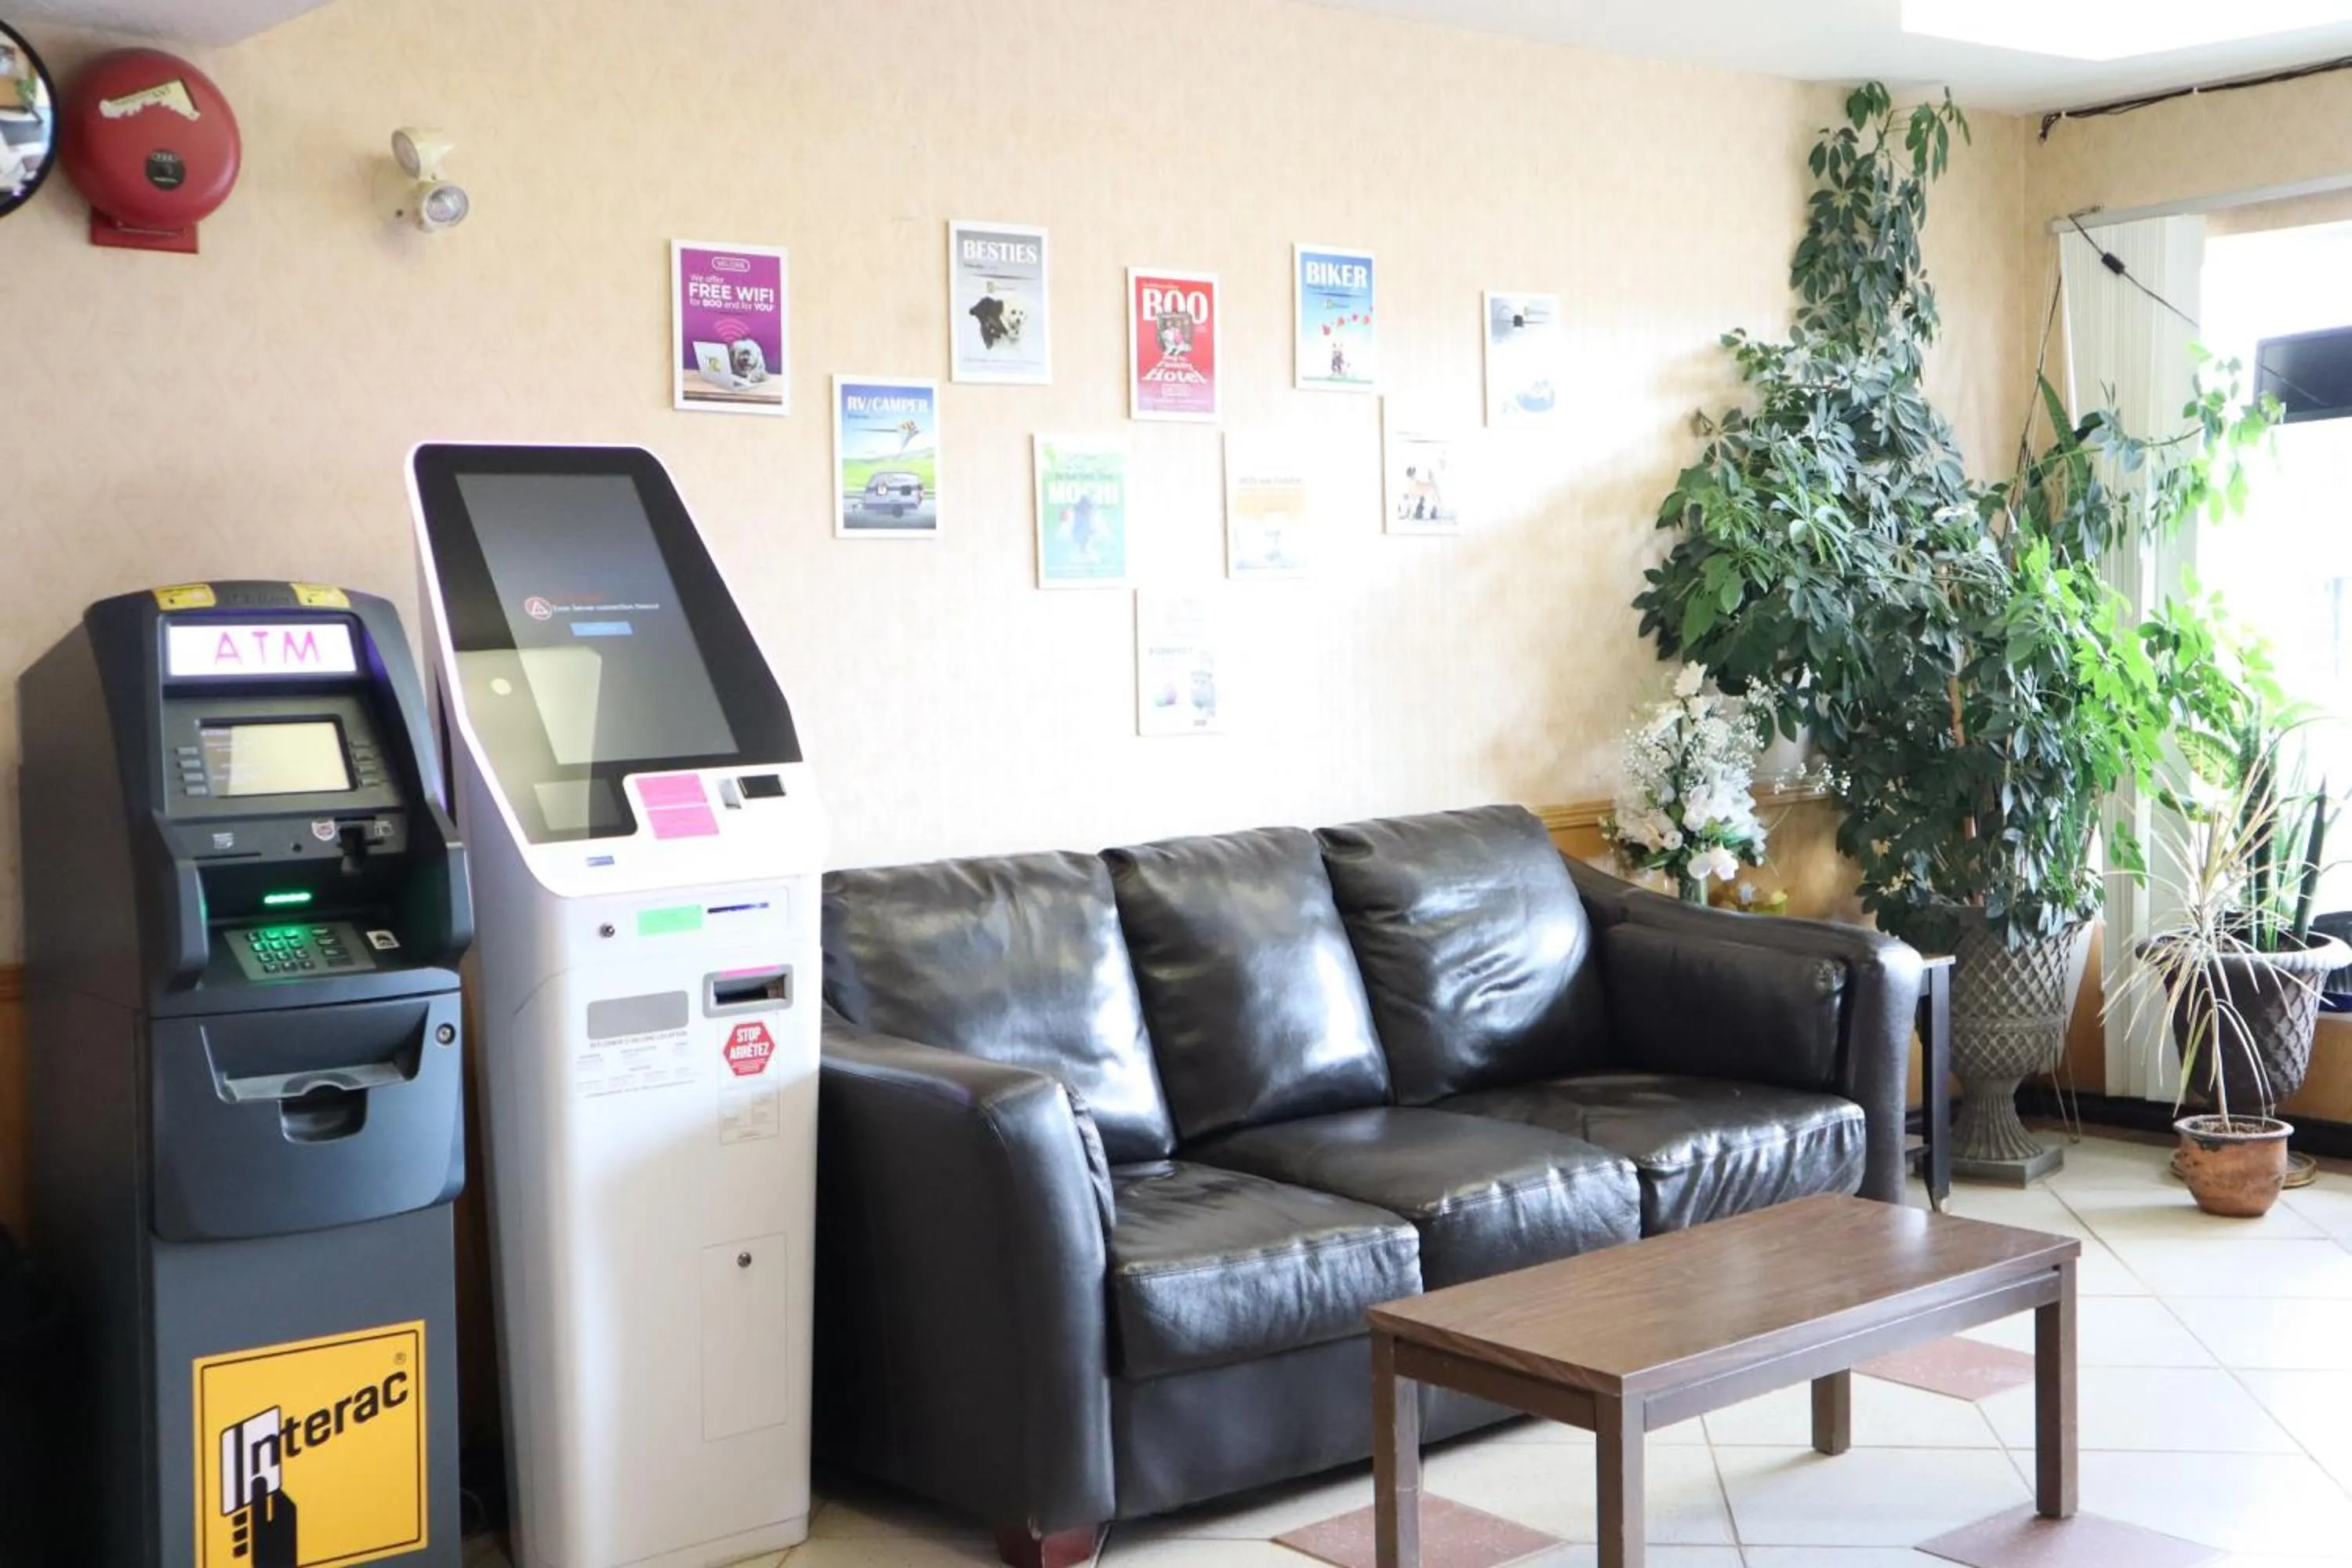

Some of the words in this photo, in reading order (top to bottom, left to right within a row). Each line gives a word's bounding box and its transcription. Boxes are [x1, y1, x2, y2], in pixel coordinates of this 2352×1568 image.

[964, 239, 1038, 264] BESTIES
[1306, 262, 1367, 288] BIKER
[689, 281, 731, 300] FREE
[735, 286, 775, 303] WIFI
[702, 299, 723, 308] BOO
[1142, 288, 1208, 325] BOO
[848, 395, 929, 412] RV/CAMPER
[214, 630, 321, 665] ATM
[736, 1026, 761, 1043] STOP
[234, 1370, 408, 1509] Interac
